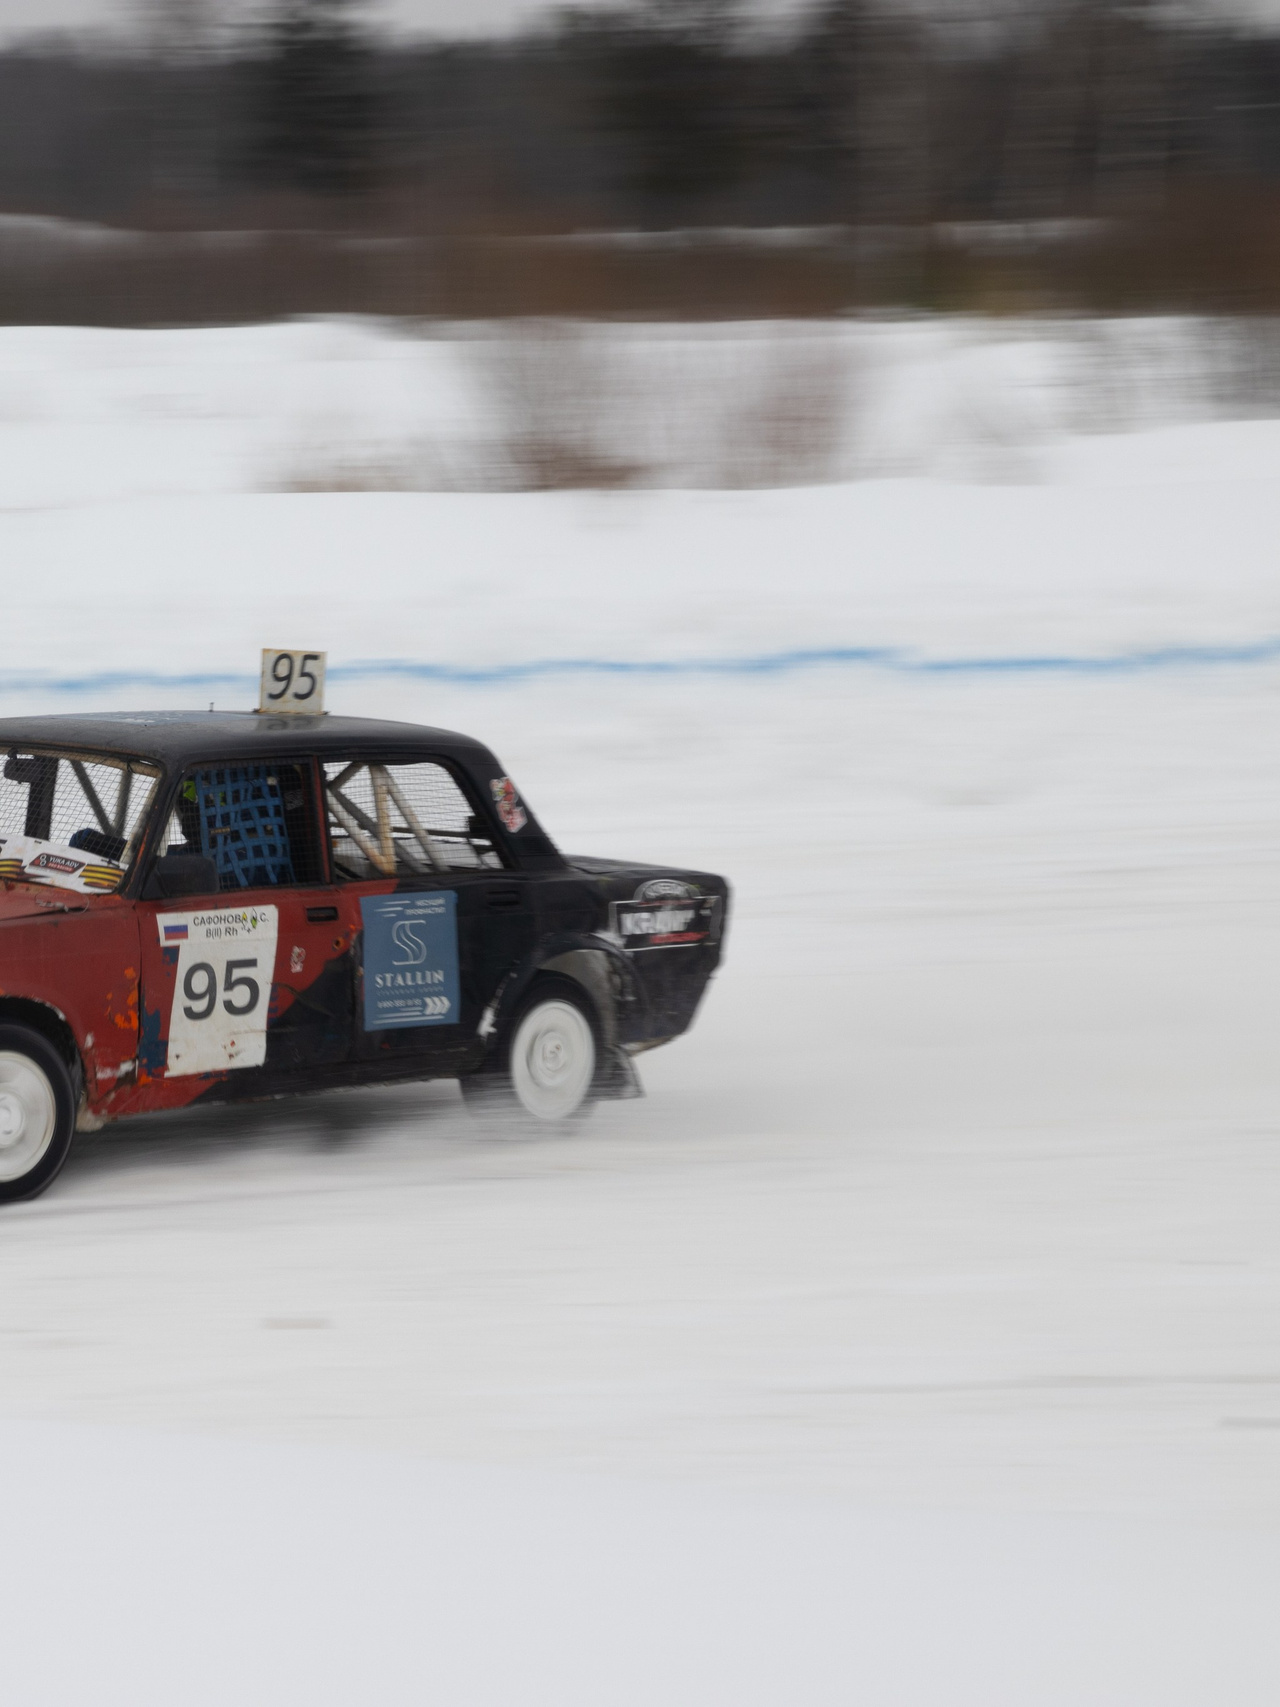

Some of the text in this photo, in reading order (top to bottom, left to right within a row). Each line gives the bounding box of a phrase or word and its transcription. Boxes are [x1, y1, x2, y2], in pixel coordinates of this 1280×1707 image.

[268, 653, 320, 700] 95
[183, 959, 260, 1021] 95
[375, 970, 444, 988] STALLIN
